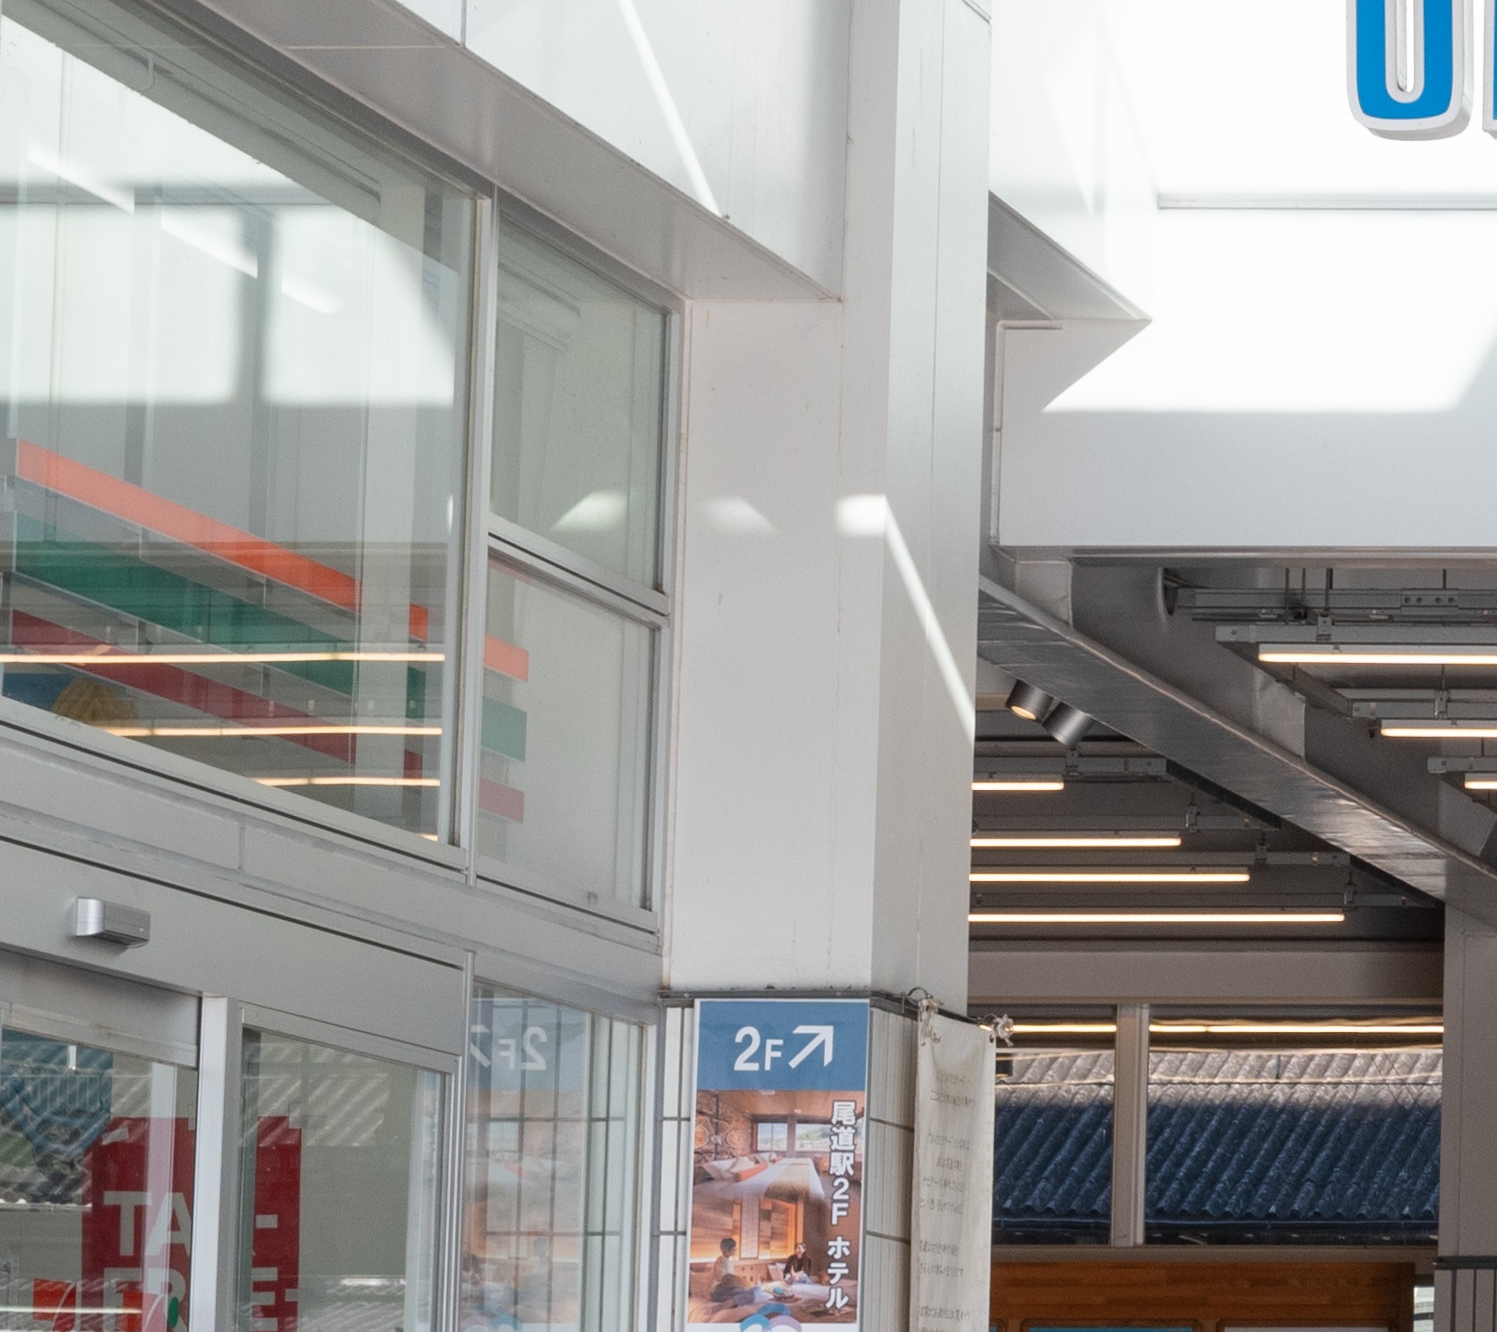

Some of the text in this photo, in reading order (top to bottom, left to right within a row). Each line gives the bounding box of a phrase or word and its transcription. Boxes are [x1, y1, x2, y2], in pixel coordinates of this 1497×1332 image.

[733, 1025, 785, 1072] 2F
[824, 1099, 857, 1312] 尾道駅2F ホテル
